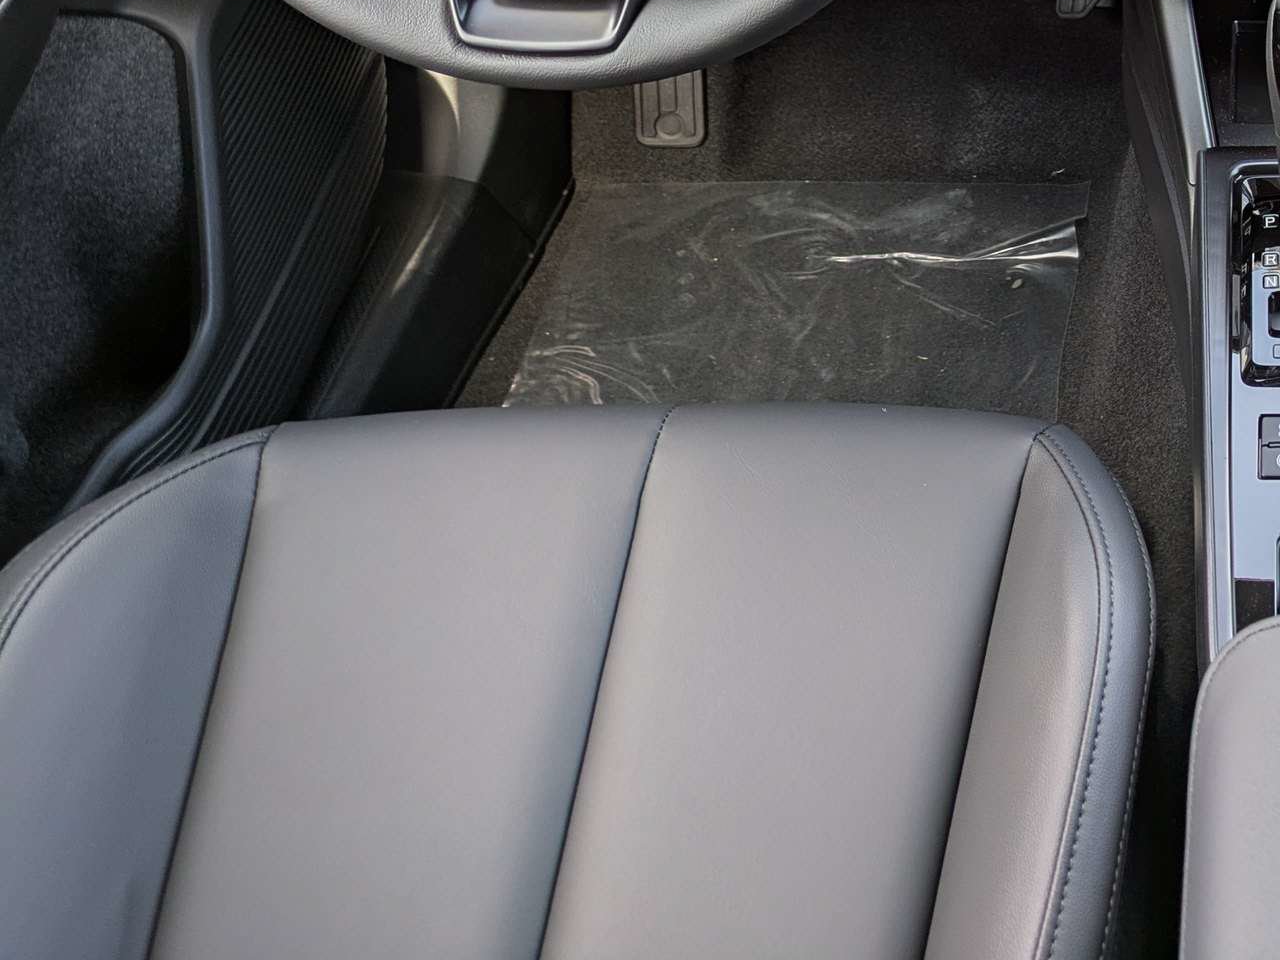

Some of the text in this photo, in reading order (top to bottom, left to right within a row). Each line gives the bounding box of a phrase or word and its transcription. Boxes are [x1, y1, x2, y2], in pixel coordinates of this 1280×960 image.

[1264, 216, 1276, 227] P
[1265, 254, 1277, 265] R
[1264, 275, 1277, 287] N
